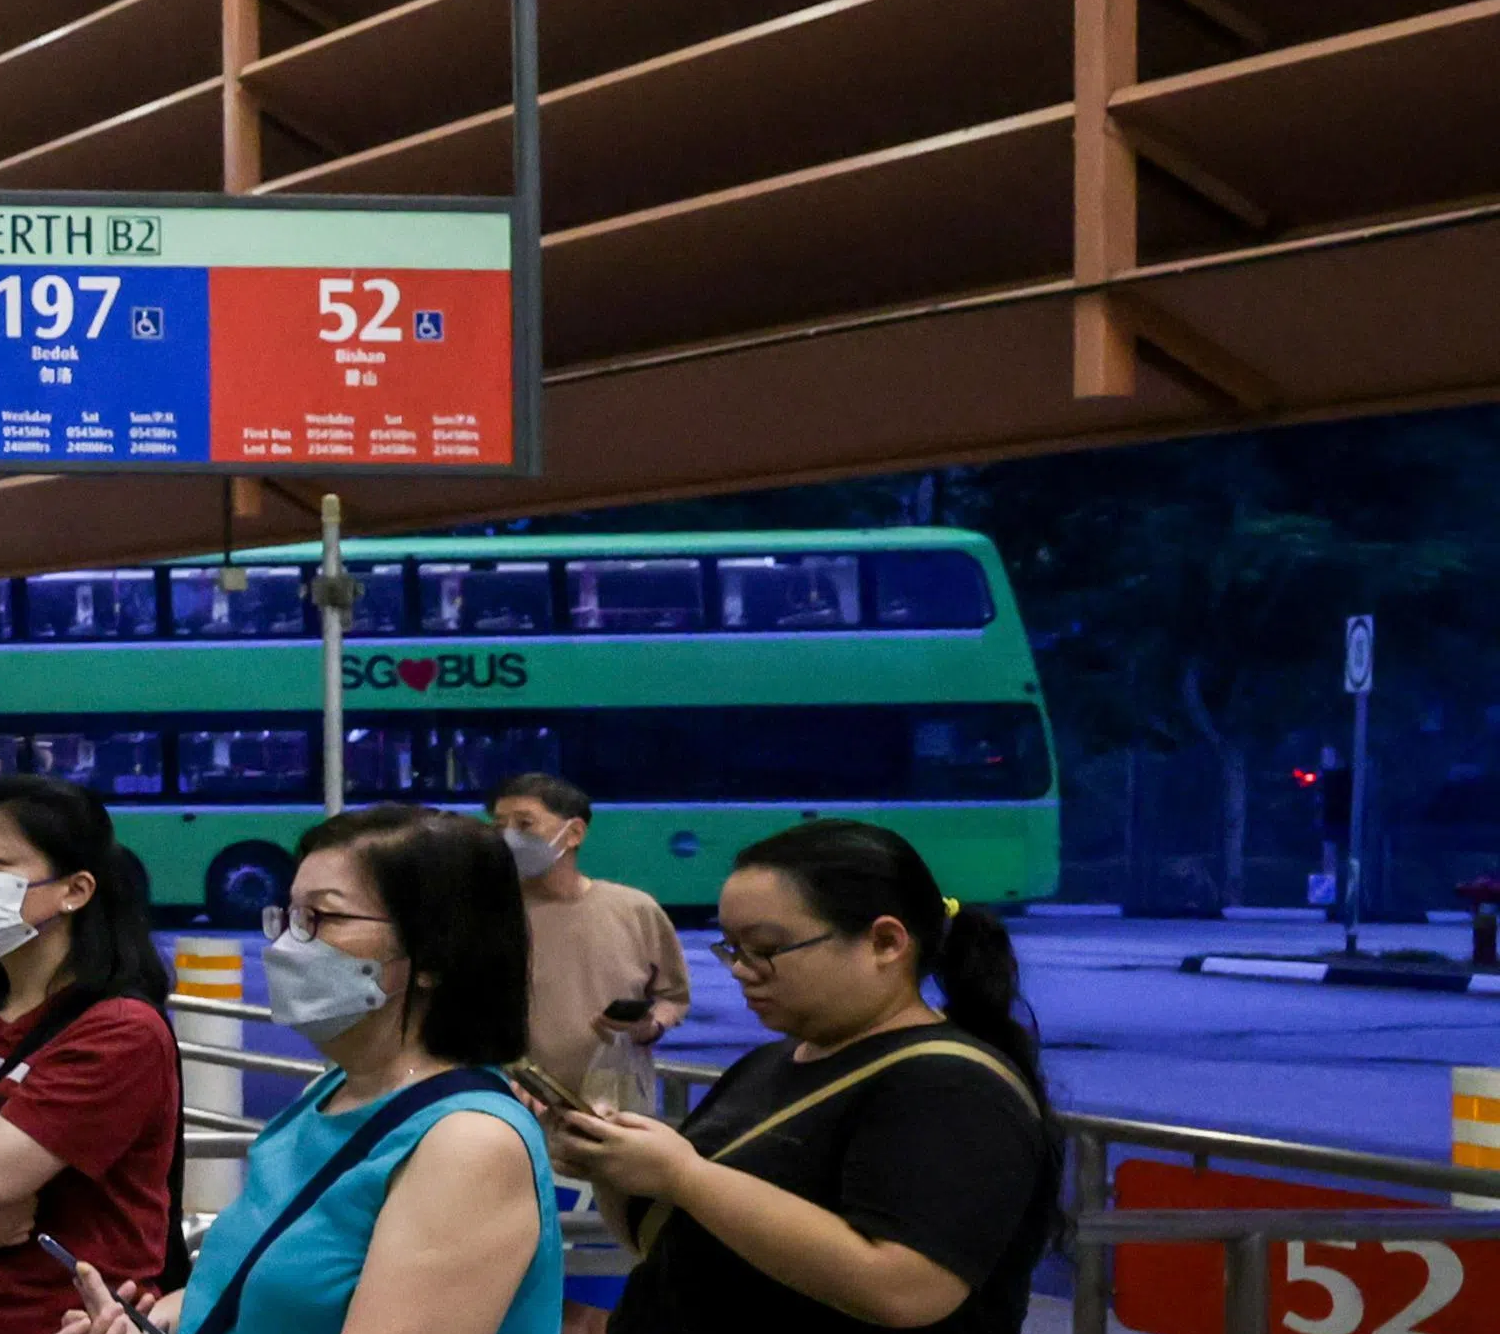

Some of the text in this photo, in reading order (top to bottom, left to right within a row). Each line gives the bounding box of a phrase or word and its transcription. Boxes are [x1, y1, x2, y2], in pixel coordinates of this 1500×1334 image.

[112, 219, 158, 253] B2
[318, 278, 403, 343] 52
[31, 345, 79, 362] Bedok
[436, 652, 528, 689] BUS
